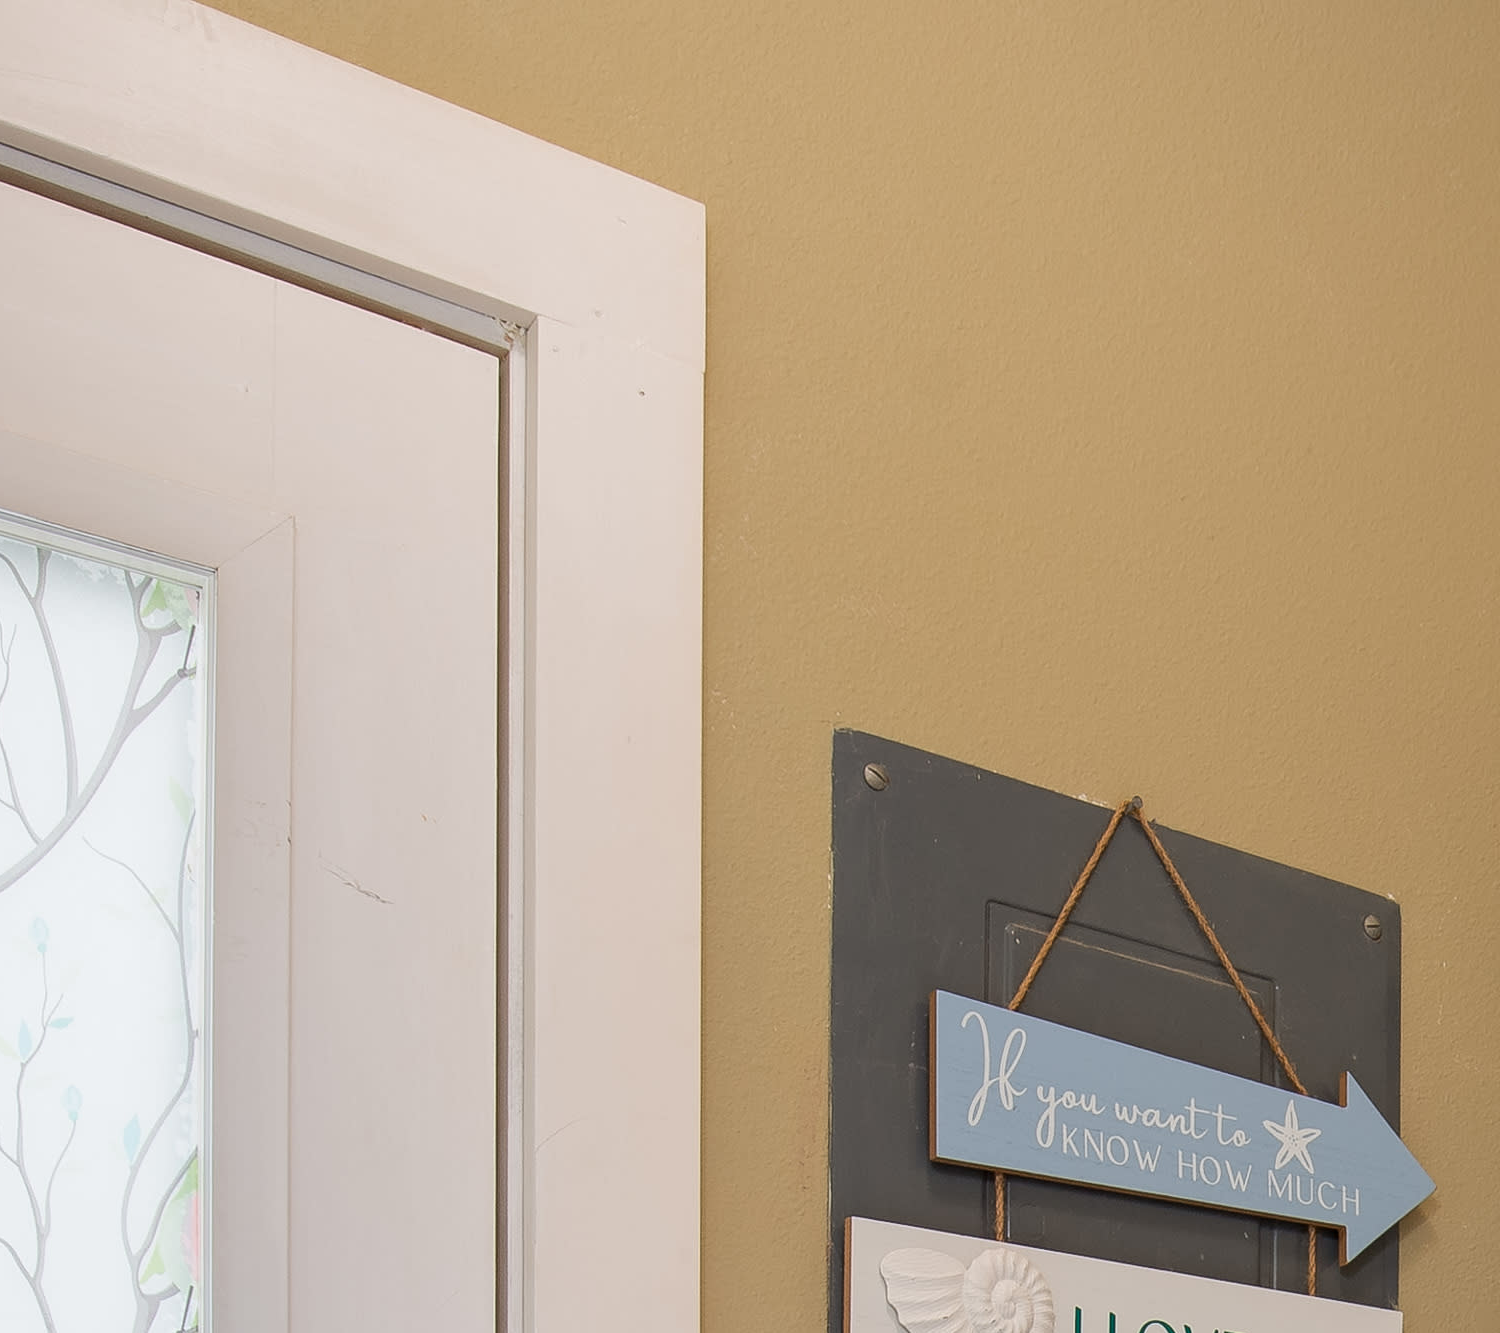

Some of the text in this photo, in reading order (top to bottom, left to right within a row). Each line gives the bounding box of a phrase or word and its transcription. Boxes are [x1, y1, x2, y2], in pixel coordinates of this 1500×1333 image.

[961, 1010, 1252, 1149] If you want to
[1062, 1127, 1362, 1216] KNOW HOW MUCH
